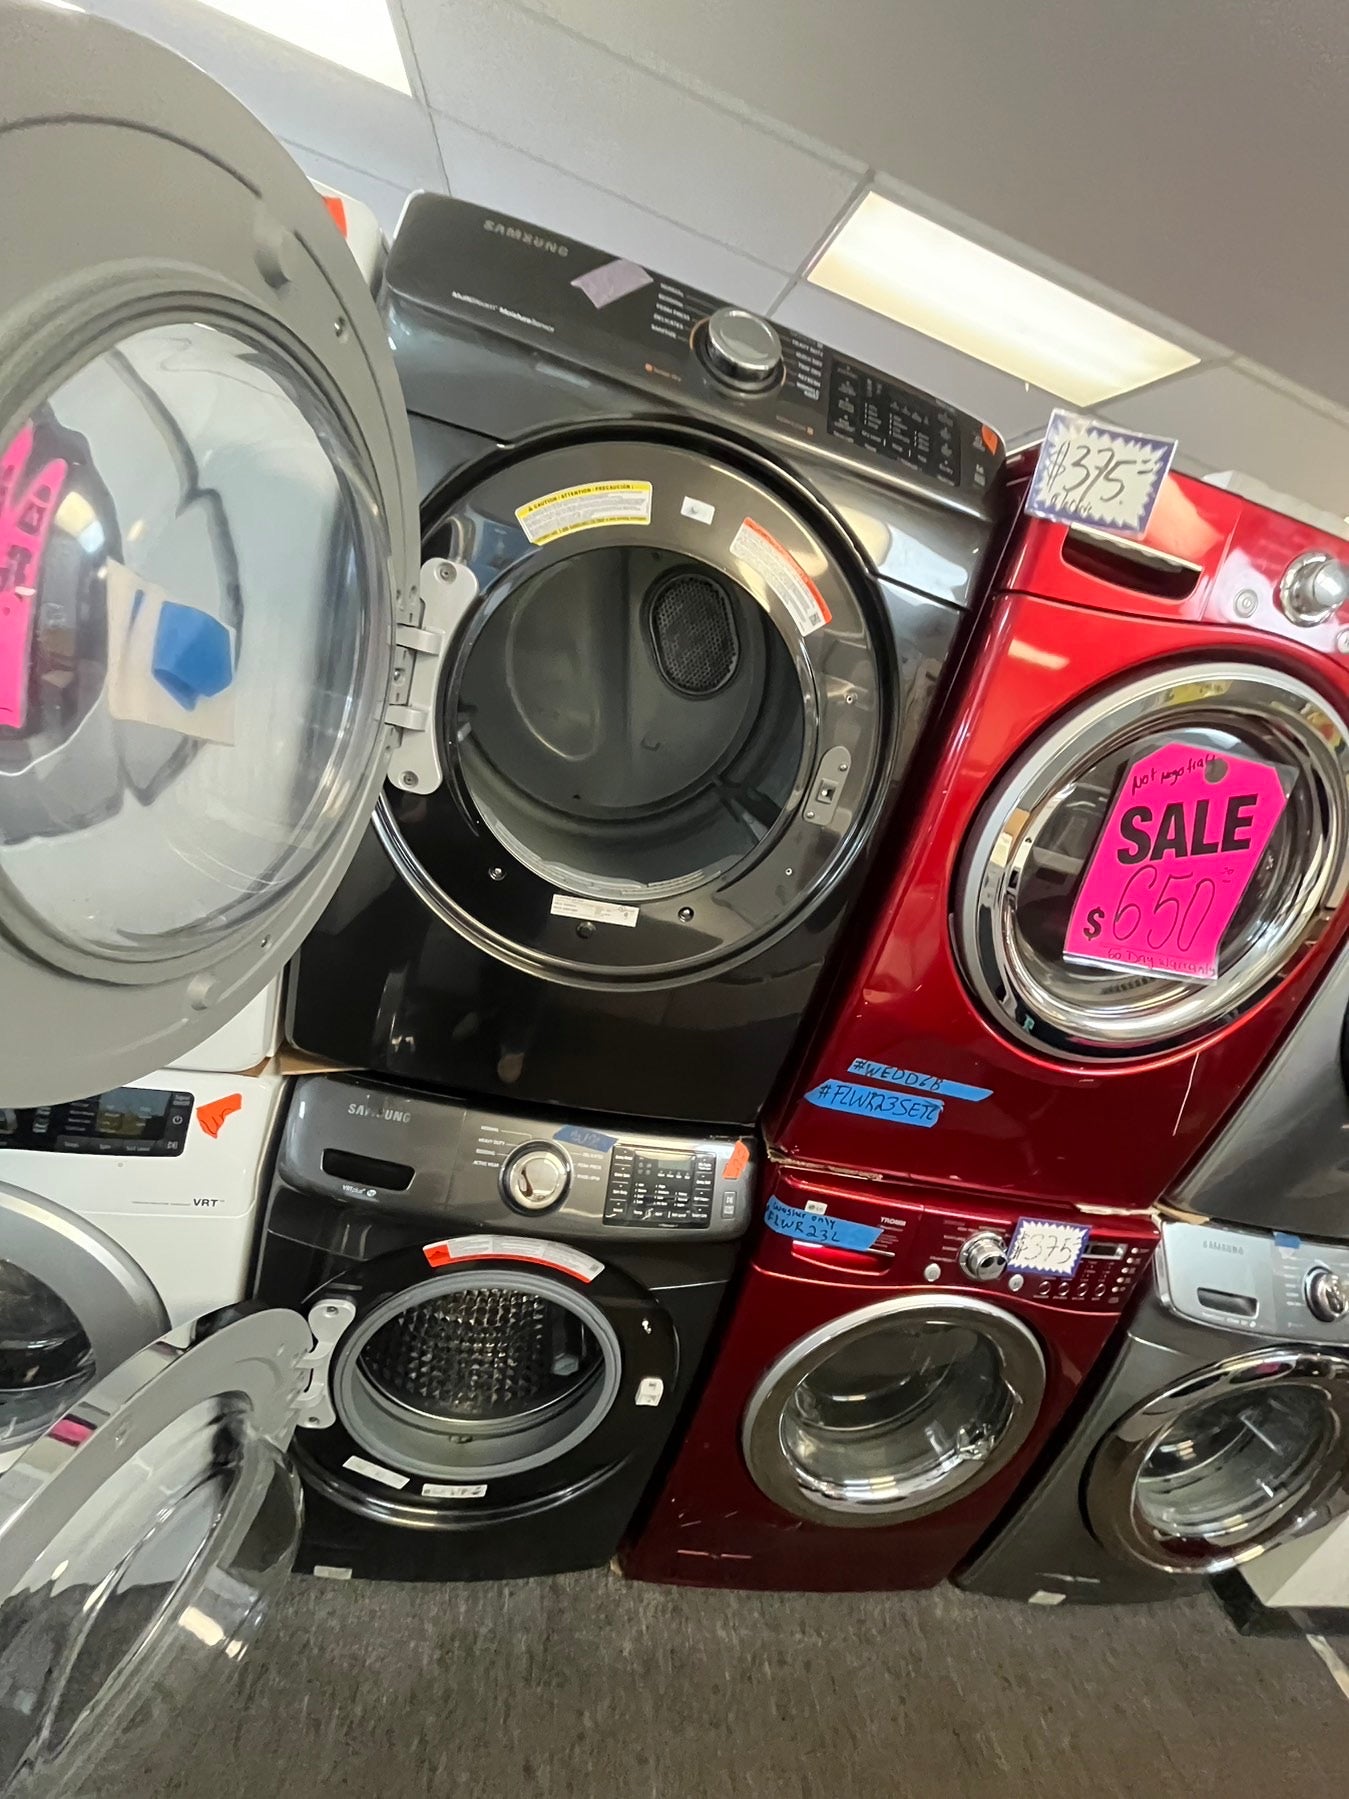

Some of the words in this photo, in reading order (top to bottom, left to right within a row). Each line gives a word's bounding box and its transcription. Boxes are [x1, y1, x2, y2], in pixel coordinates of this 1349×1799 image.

[484, 218, 569, 258] SAMSUNG
[1117, 794, 1260, 865] SALE
[347, 1102, 412, 1124] SAUNG
[810, 1213, 836, 1230] only
